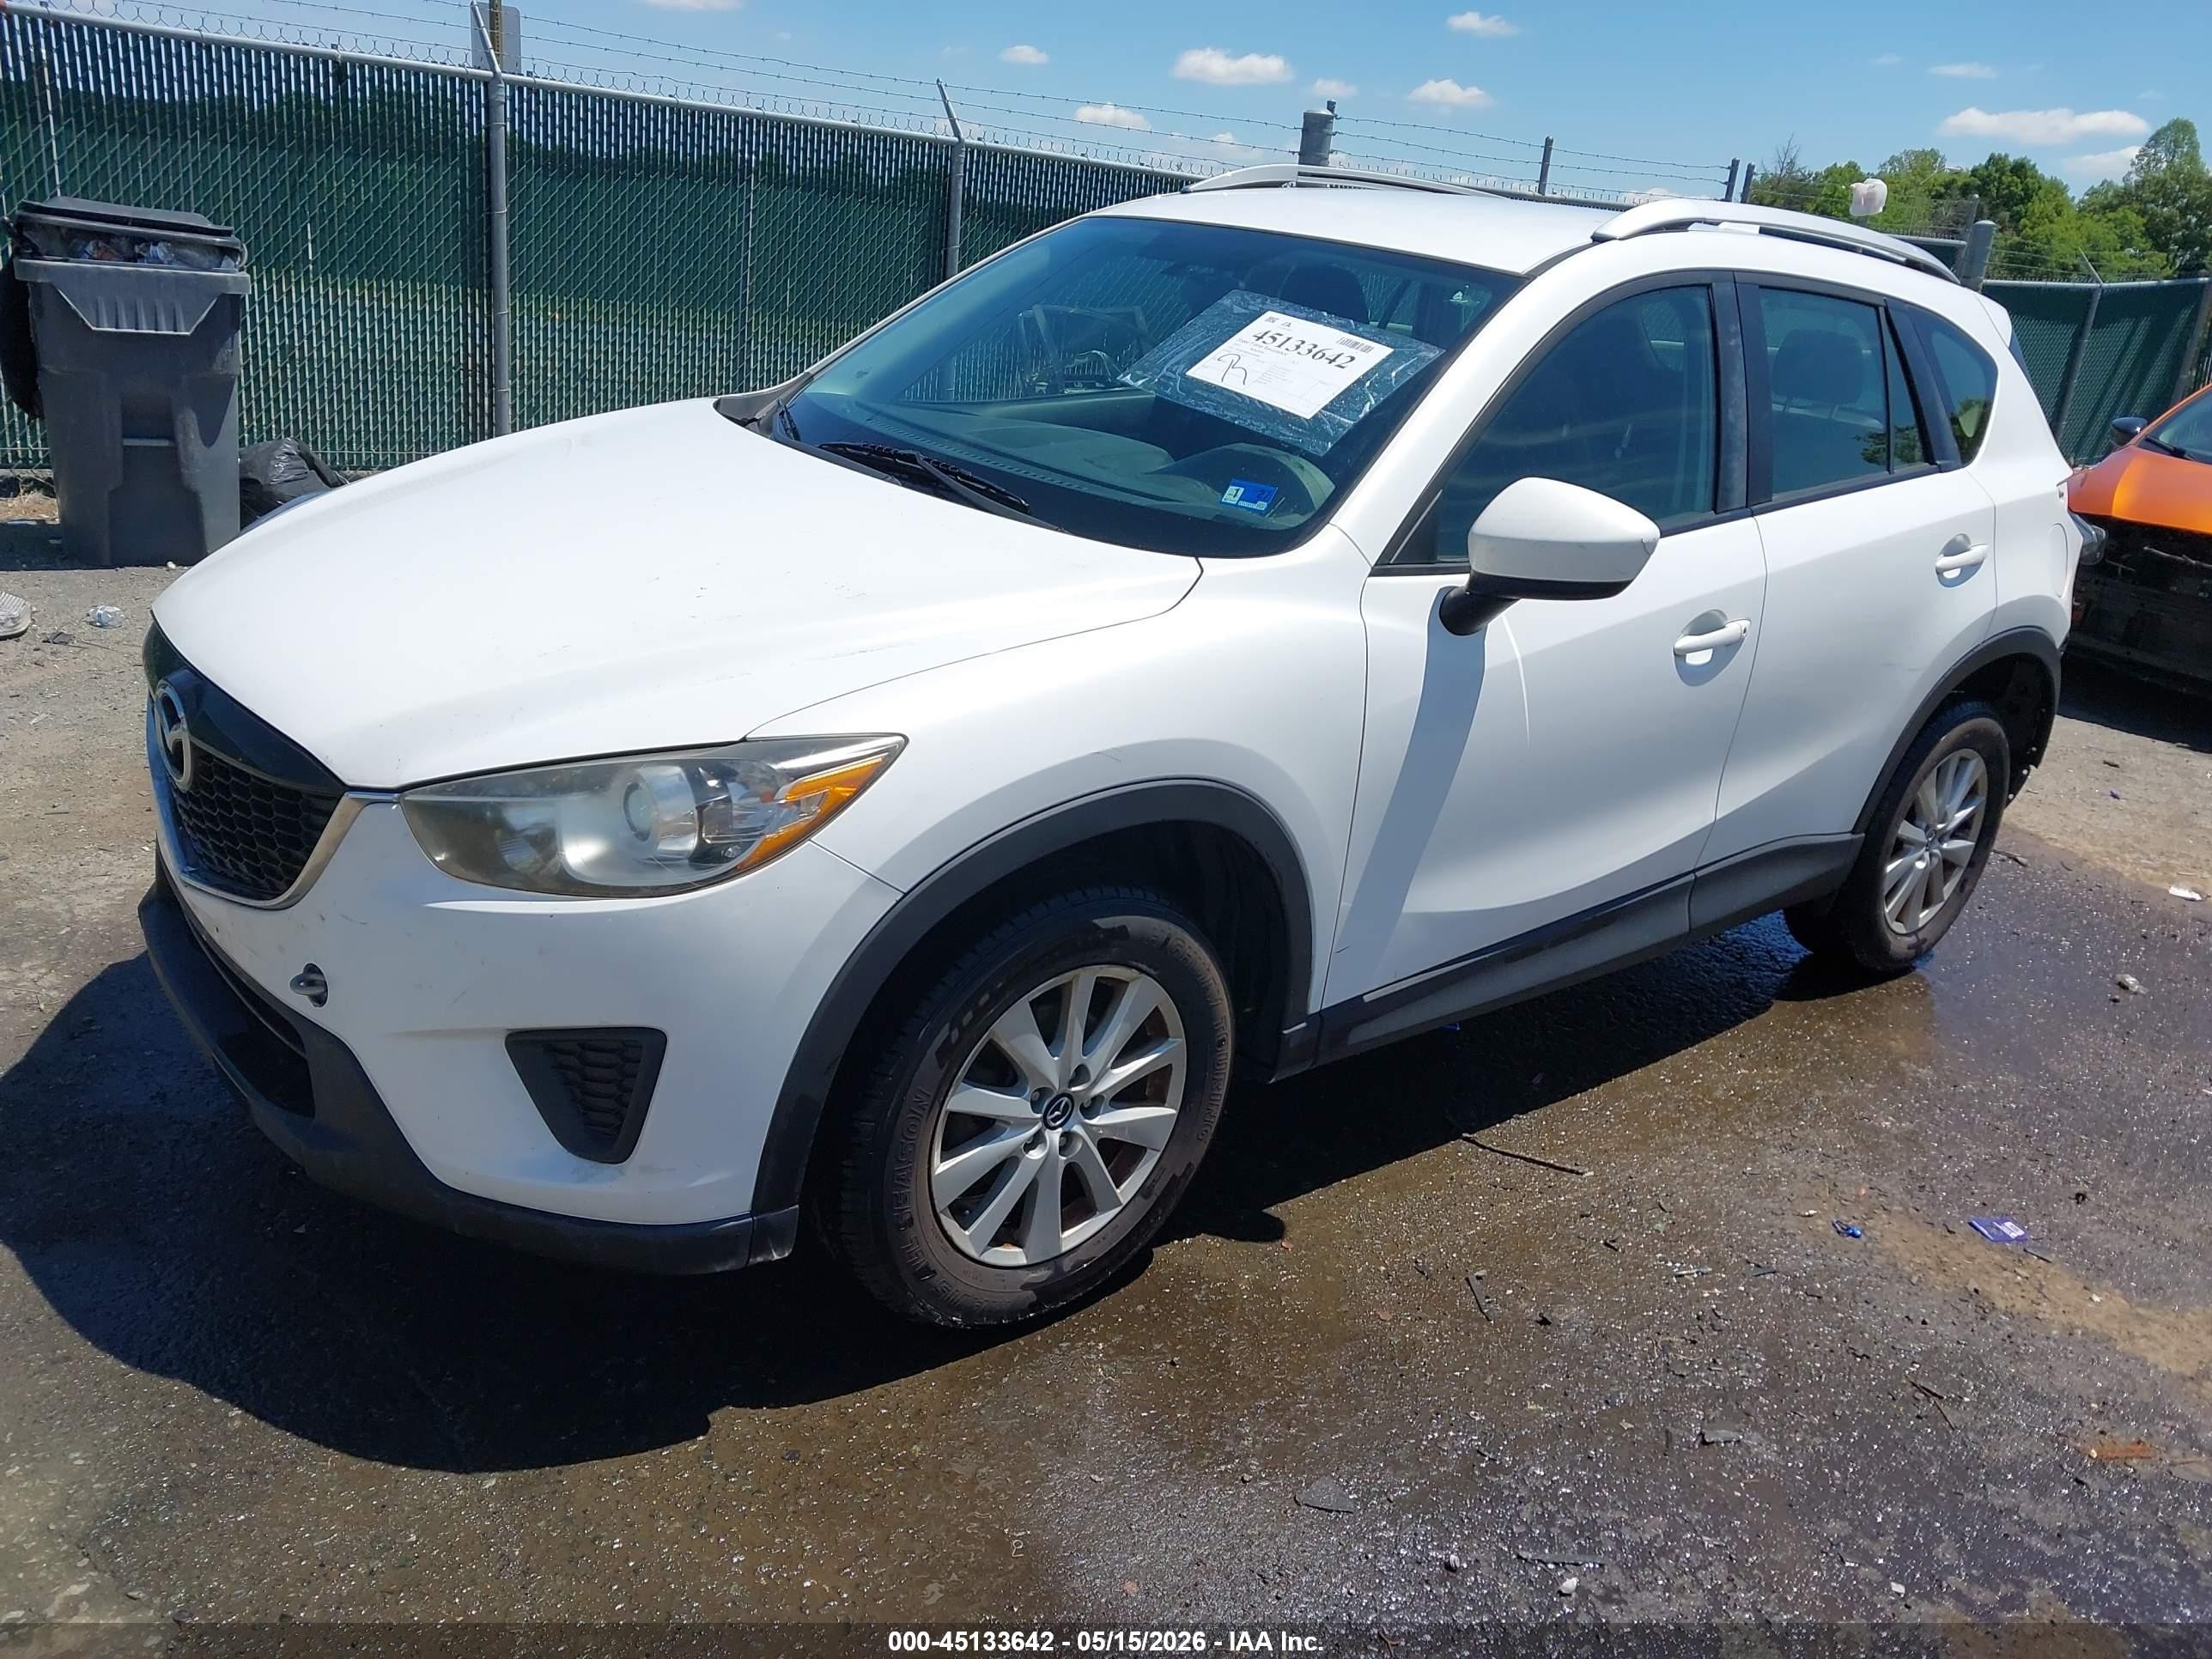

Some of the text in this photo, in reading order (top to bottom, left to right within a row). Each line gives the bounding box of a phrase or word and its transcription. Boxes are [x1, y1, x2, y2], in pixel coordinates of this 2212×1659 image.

[1252, 330, 1355, 368] 45133642
[1197, 1017, 1229, 1142] TOURING
[892, 1087, 931, 1231] SEASON
